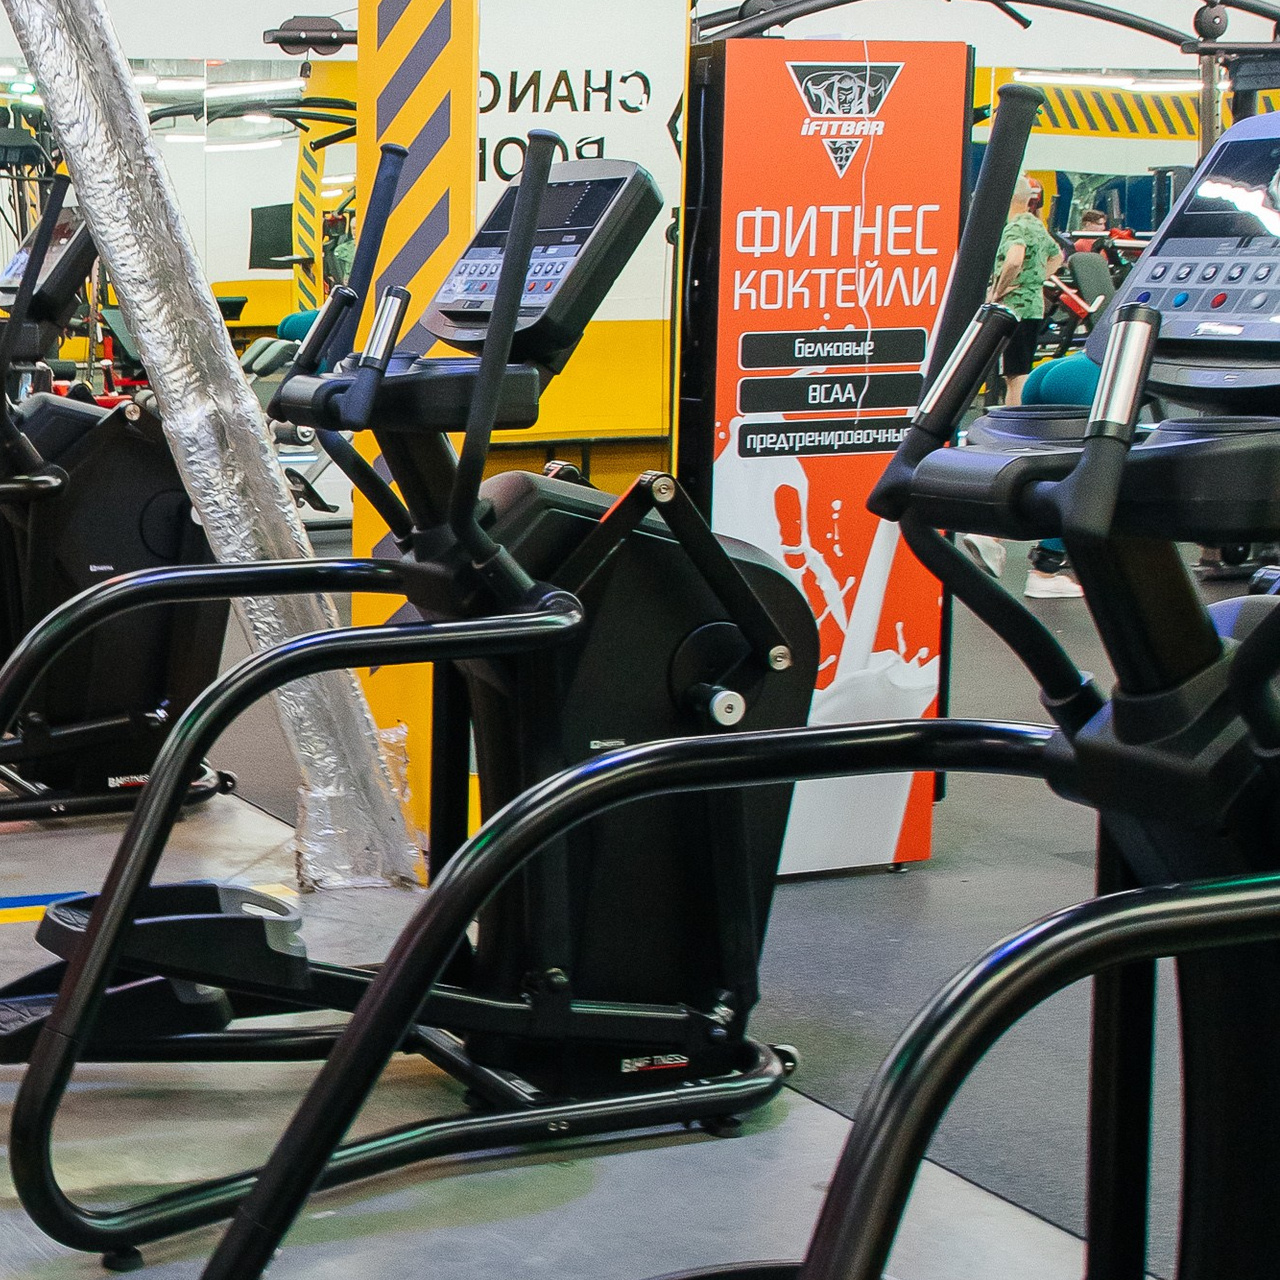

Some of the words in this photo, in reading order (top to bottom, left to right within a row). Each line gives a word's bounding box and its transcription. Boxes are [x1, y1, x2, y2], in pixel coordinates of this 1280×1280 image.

[800, 118, 885, 136] iFITBAR
[735, 204, 940, 258] ФИТНЕС
[733, 260, 938, 310] КОКТЕЙЛИ
